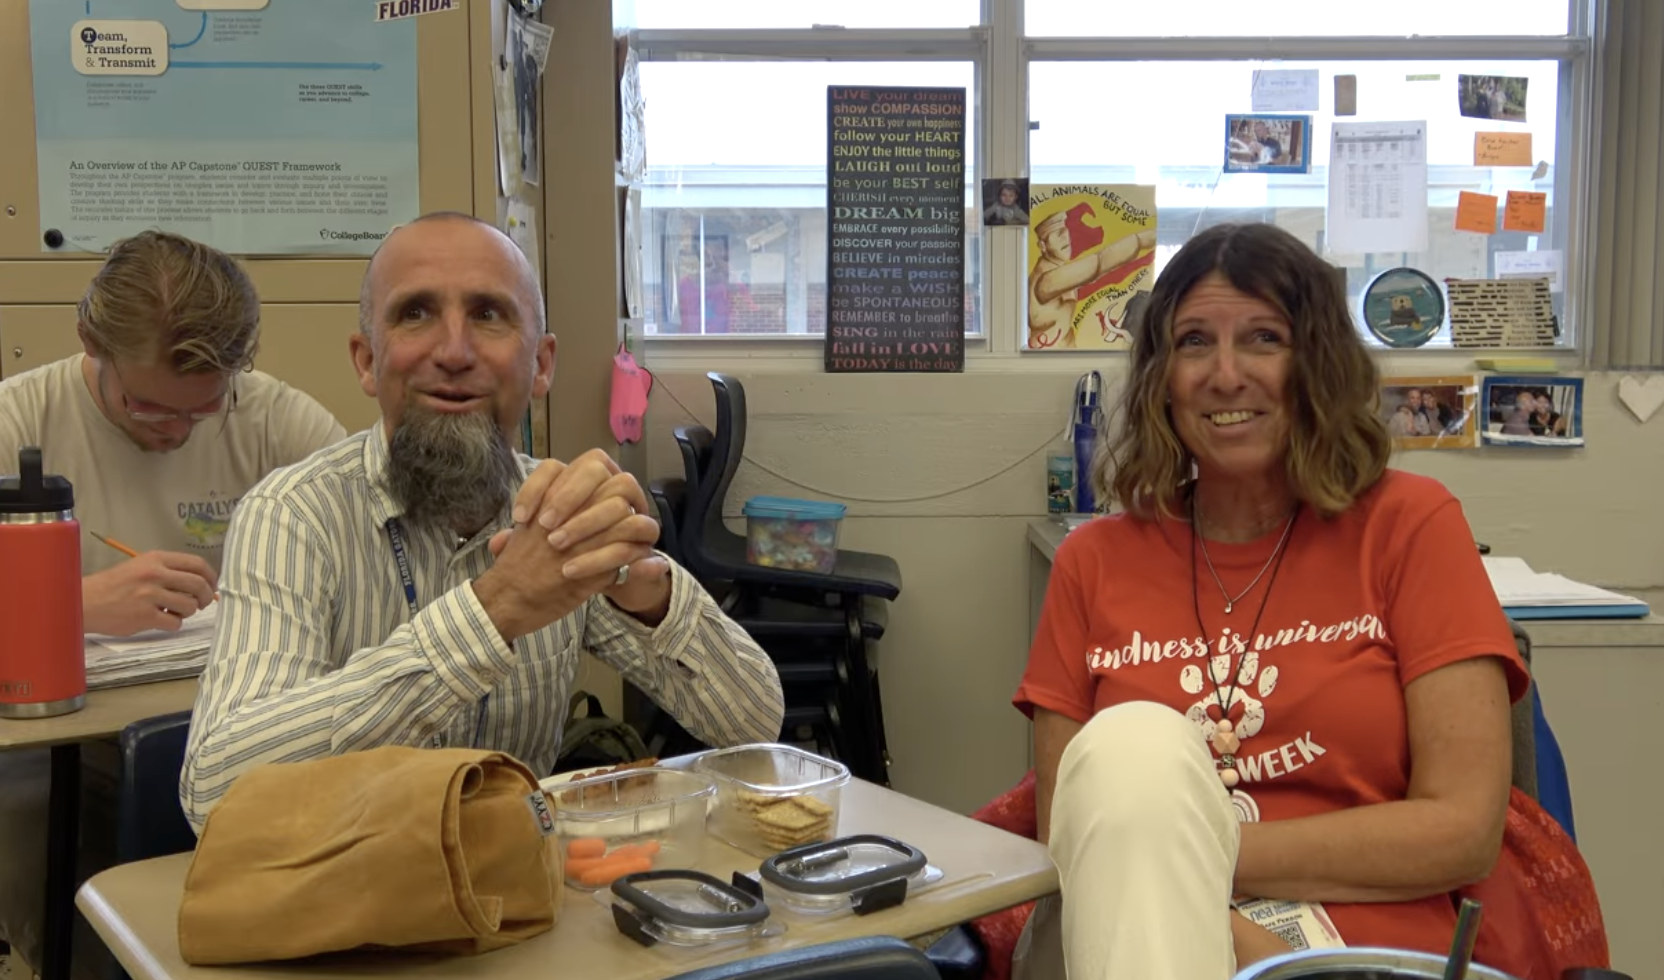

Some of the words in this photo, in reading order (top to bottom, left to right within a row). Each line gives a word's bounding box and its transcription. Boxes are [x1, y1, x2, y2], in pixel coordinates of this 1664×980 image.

[380, 0, 451, 20] FLORIDA
[82, 28, 128, 43] Team,
[85, 44, 152, 55] Transform
[85, 57, 96, 68] &
[98, 57, 156, 68] Transmit
[832, 89, 869, 100] LIVE
[876, 92, 907, 103] your
[913, 90, 962, 101] dream
[833, 103, 867, 115] show
[870, 103, 962, 115] COMPASSION
[833, 117, 885, 128] CREATE
[887, 120, 904, 130] your
[906, 120, 922, 128] own
[923, 117, 962, 131] happiness
[833, 130, 875, 142] follow
[880, 133, 910, 145] your
[914, 131, 961, 143] HEART
[833, 145, 869, 156] ENJOY
[871, 145, 891, 157] the
[894, 146, 922, 157] little
[924, 146, 961, 160] things
[69, 161, 84, 170] An
[86, 161, 135, 170] Overview
[137, 161, 147, 170] of
[150, 161, 167, 170] the
[170, 161, 186, 170] AP
[242, 162, 278, 171] QUEST
[282, 162, 340, 171] Framework
[835, 161, 890, 173] LAUGH
[895, 161, 920, 173] out
[925, 161, 961, 173] loud
[833, 177, 849, 189] be
[854, 180, 886, 191] your
[892, 177, 926, 189] BEST
[934, 177, 960, 189] self
[833, 192, 886, 203] CHERISH
[888, 195, 914, 206] every
[1030, 193, 1049, 210] ALL
[1052, 186, 1099, 198] ANIMALS
[1101, 189, 1121, 203] ARE
[1121, 200, 1150, 217] EQUAL
[833, 207, 922, 220] DREAM
[930, 207, 960, 223] big
[1103, 200, 1121, 215] BUT
[1121, 212, 1147, 226] SOME
[330, 231, 388, 241] CollegeBoar
[833, 223, 876, 234] EMBRACE
[880, 226, 907, 236] every
[910, 224, 960, 237] possibility
[833, 238, 892, 248] DISCOVER
[894, 241, 918, 251] your
[919, 239, 960, 252] passion
[833, 253, 882, 264] BELIEVE
[888, 253, 900, 264] in
[904, 253, 960, 264] miracles
[833, 268, 902, 279] CREATE
[907, 271, 959, 282] peace
[833, 283, 884, 294] make
[891, 285, 901, 294] a
[909, 283, 960, 294] WISH
[1106, 289, 1128, 302] THAN
[1128, 269, 1149, 291] OTHERS
[832, 296, 849, 308] be
[853, 297, 960, 308] SPONTANEOUS
[1081, 297, 1097, 316] MORE
[832, 311, 895, 323] REMEMBER
[899, 311, 911, 323] to
[914, 311, 960, 323] breathe
[832, 326, 878, 338] SING
[883, 326, 896, 338] in
[902, 326, 924, 338] the
[930, 327, 959, 338] rain
[832, 342, 864, 355] fall
[870, 342, 890, 355] in
[896, 342, 960, 355] LOVE
[832, 358, 889, 370] TODAY
[894, 358, 905, 370] is
[908, 359, 930, 370] the
[933, 359, 958, 373] day
[1218, 628, 1249, 654] is
[1236, 731, 1327, 782] WEEK
[1249, 906, 1274, 922] nea
